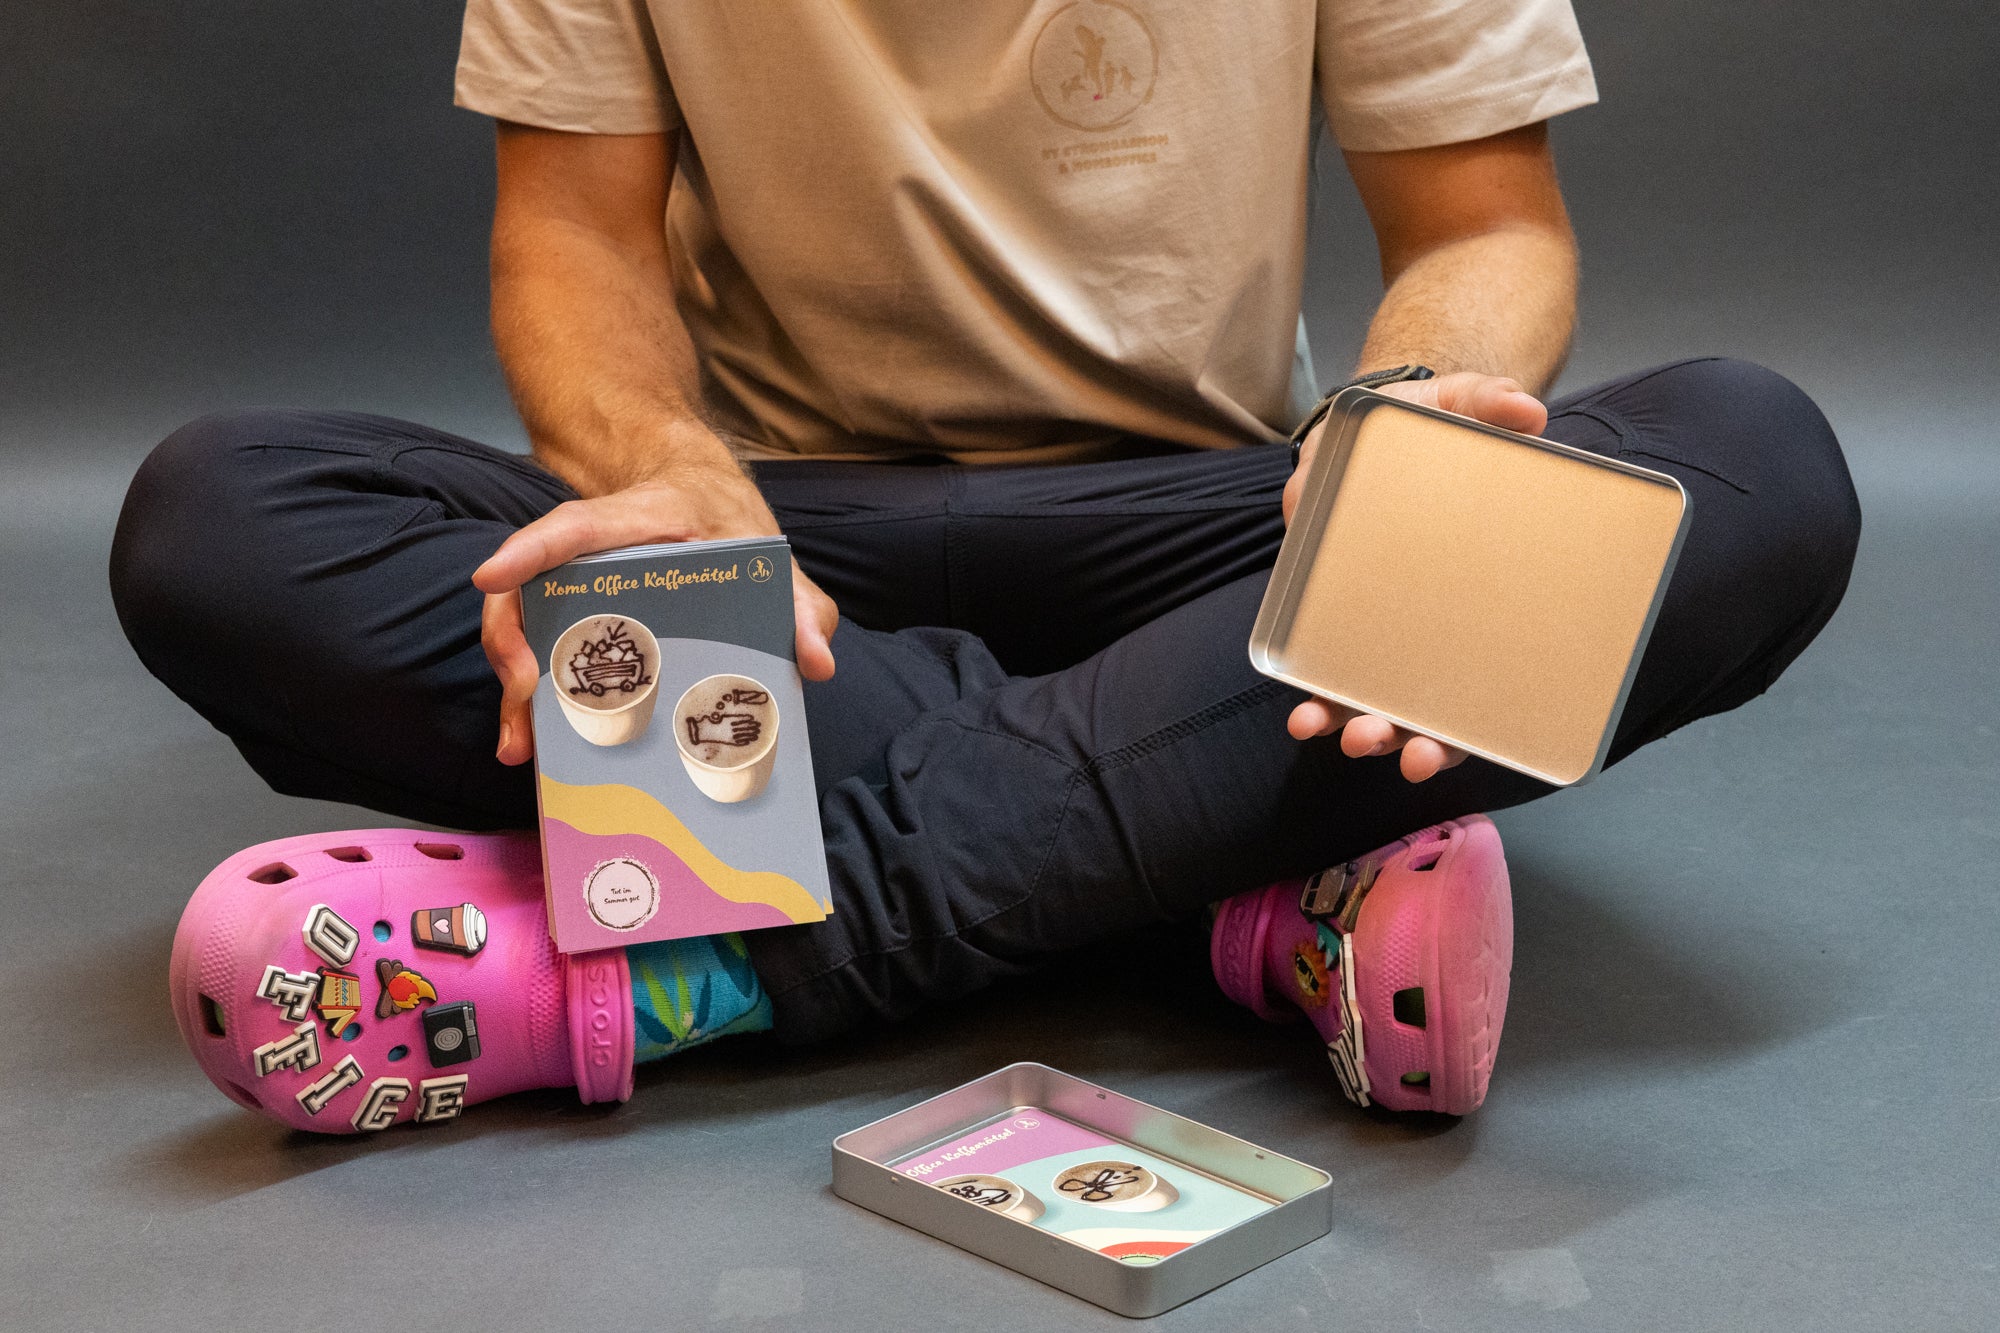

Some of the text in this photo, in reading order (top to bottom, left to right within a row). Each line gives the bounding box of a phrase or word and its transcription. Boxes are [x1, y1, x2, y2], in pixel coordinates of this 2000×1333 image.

[544, 564, 739, 597] Home Office Kaffeerätsel
[253, 904, 468, 1131] OFFICE
[588, 965, 611, 1067] crocs
